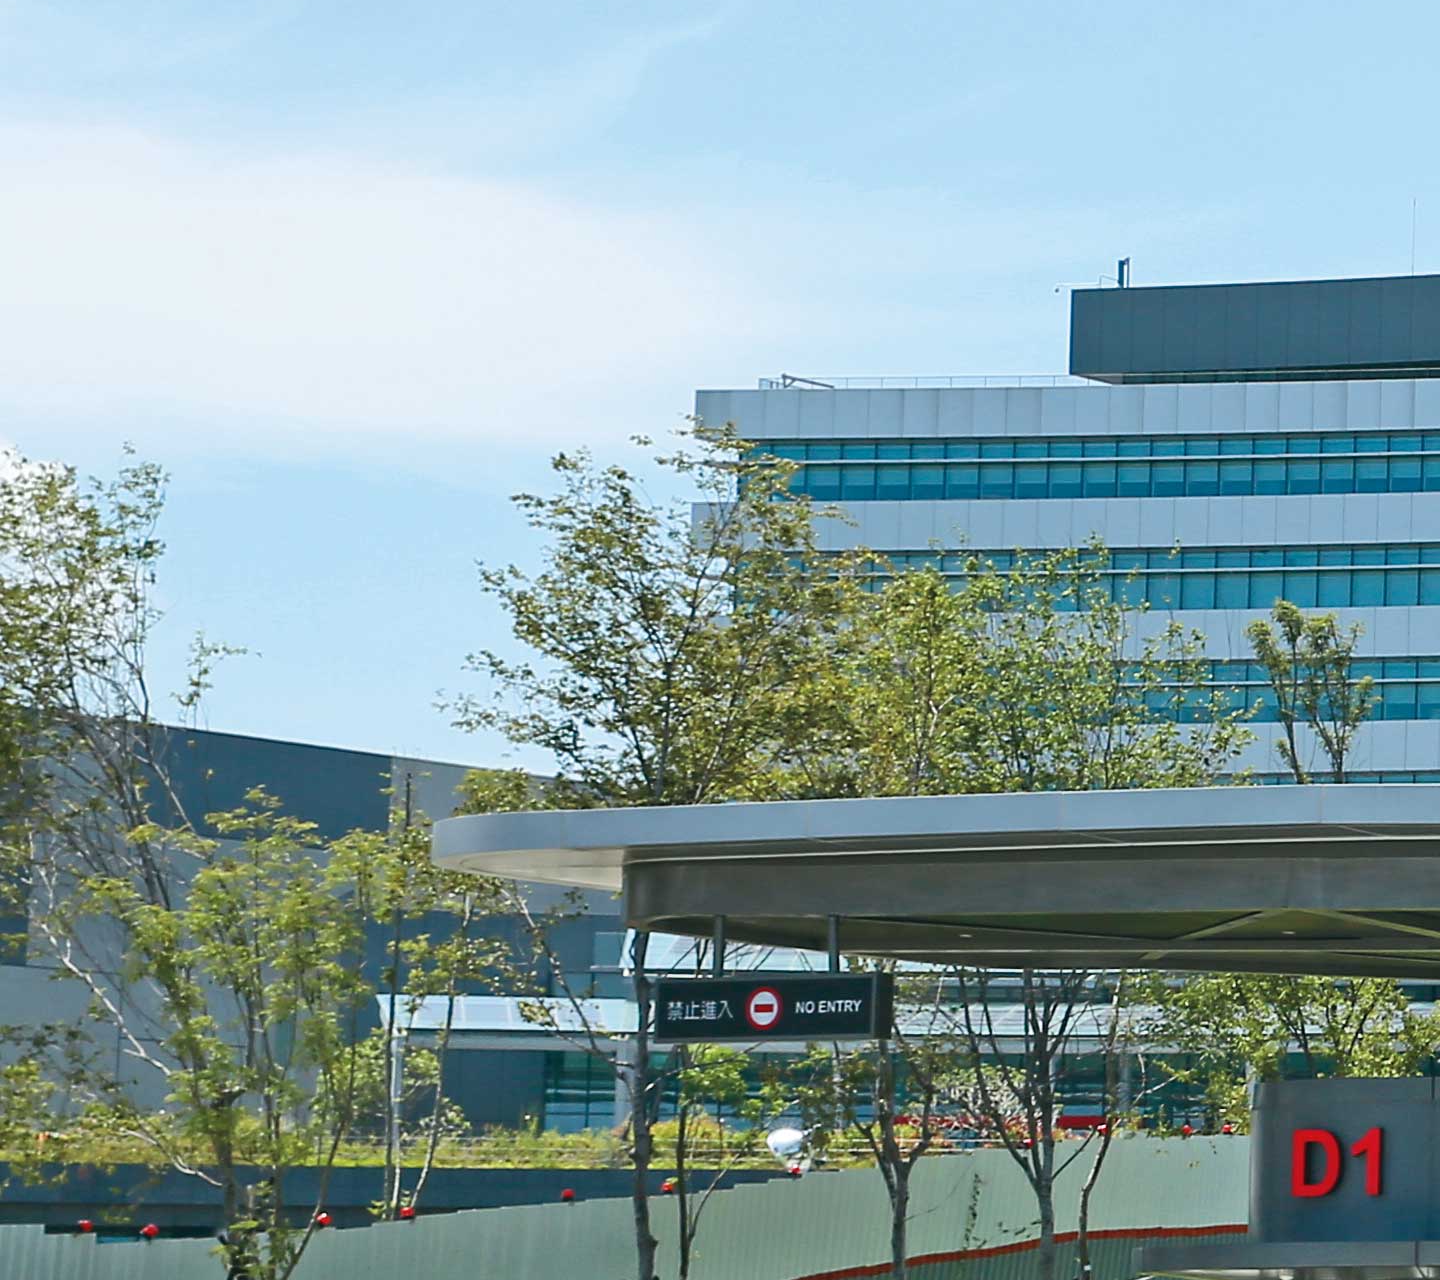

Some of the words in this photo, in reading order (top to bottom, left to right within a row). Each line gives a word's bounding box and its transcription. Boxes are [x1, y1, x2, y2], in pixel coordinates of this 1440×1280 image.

[667, 1000, 733, 1020] 禁止進入
[795, 1001, 815, 1014] NO
[818, 999, 862, 1013] ENTRY
[1291, 1127, 1383, 1197] D1
